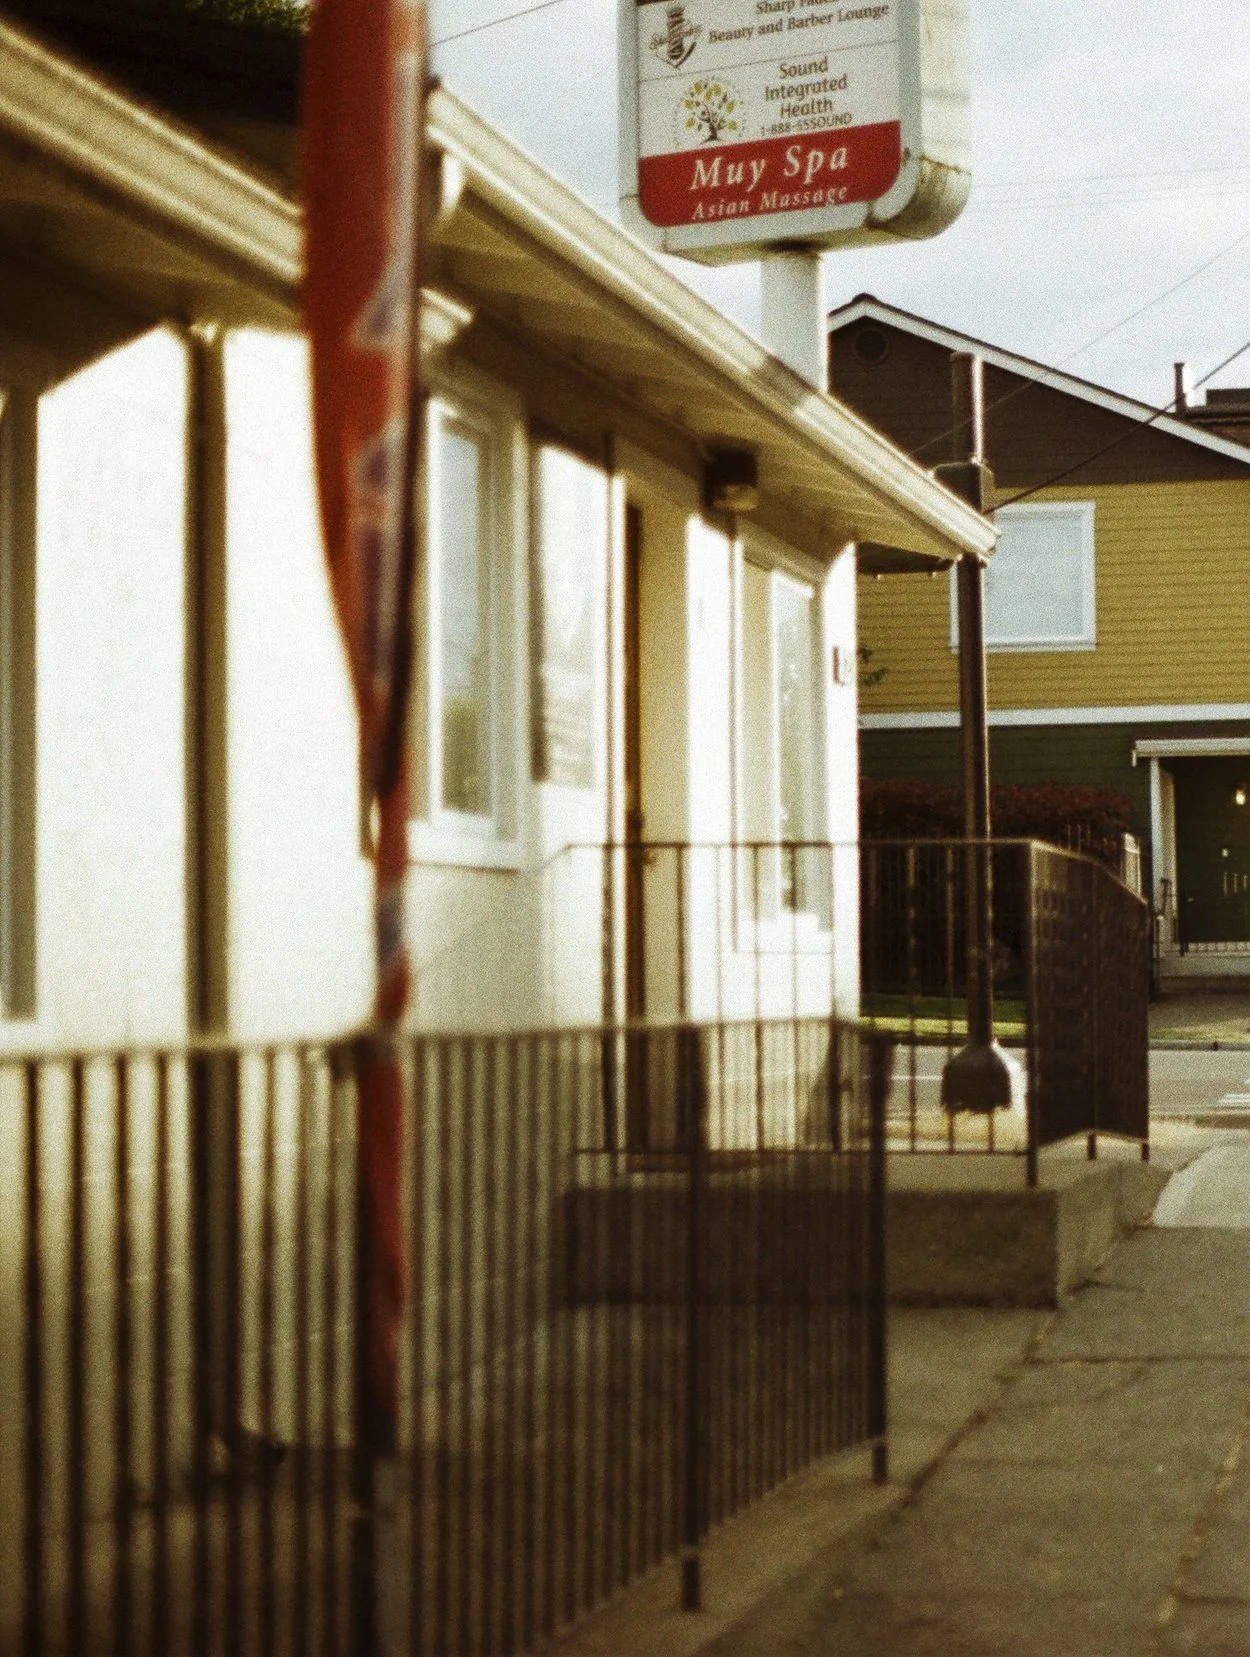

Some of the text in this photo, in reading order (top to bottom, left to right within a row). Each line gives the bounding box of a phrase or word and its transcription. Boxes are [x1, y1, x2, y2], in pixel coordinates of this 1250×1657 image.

[755, 0, 795, 14] Sharp
[709, 26, 754, 43] Beauty
[758, 18, 783, 35] and
[788, 12, 833, 30] Barber
[838, 4, 889, 22] Lounge
[780, 56, 828, 79] Sound
[765, 73, 847, 101] Integrated
[780, 98, 833, 118] Health
[690, 145, 848, 192] Muy Spa
[691, 186, 848, 220] Asian Massage
